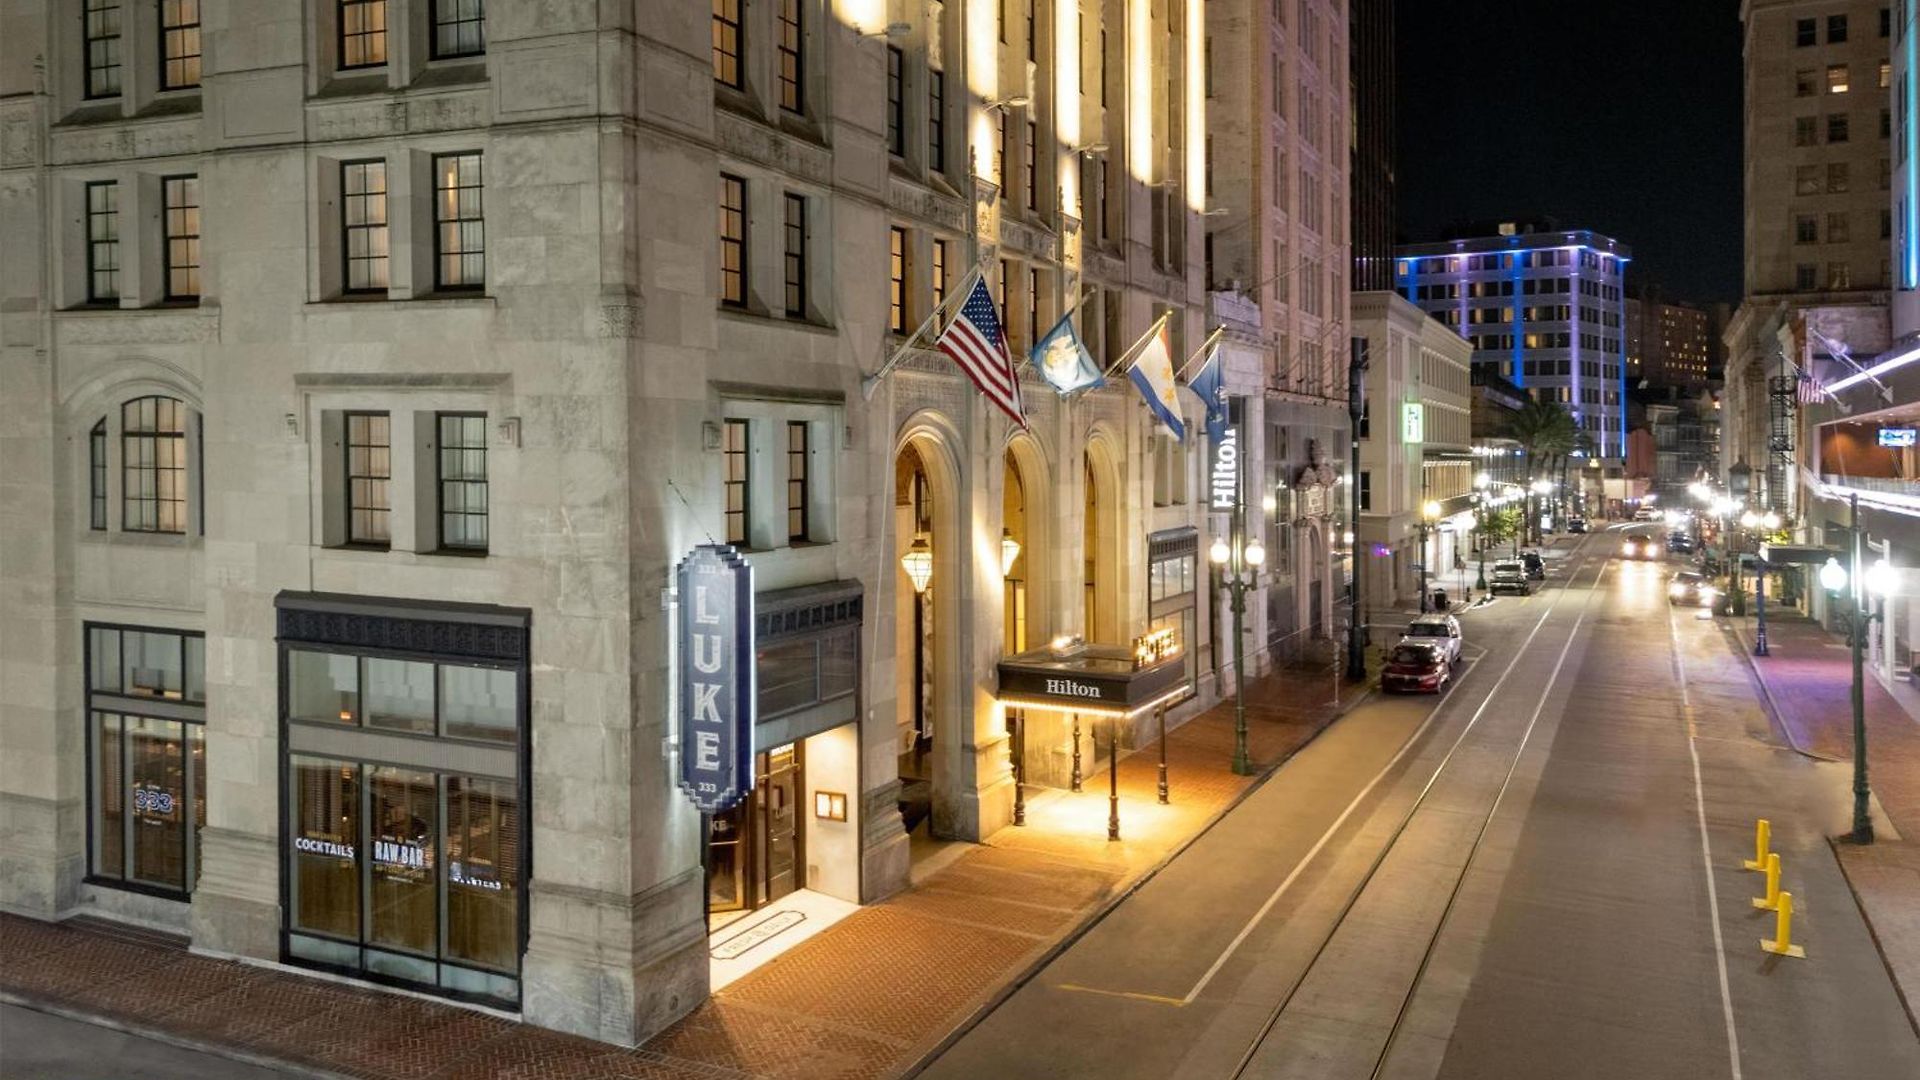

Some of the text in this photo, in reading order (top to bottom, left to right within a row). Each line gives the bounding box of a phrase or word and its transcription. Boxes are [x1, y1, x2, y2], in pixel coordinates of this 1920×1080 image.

[692, 586, 723, 772] LUKE
[1046, 679, 1101, 698] Hilton
[699, 782, 717, 793] 333
[135, 789, 173, 813] 333
[295, 838, 354, 858] COCKTAILS
[375, 841, 423, 867] RAW BAR
